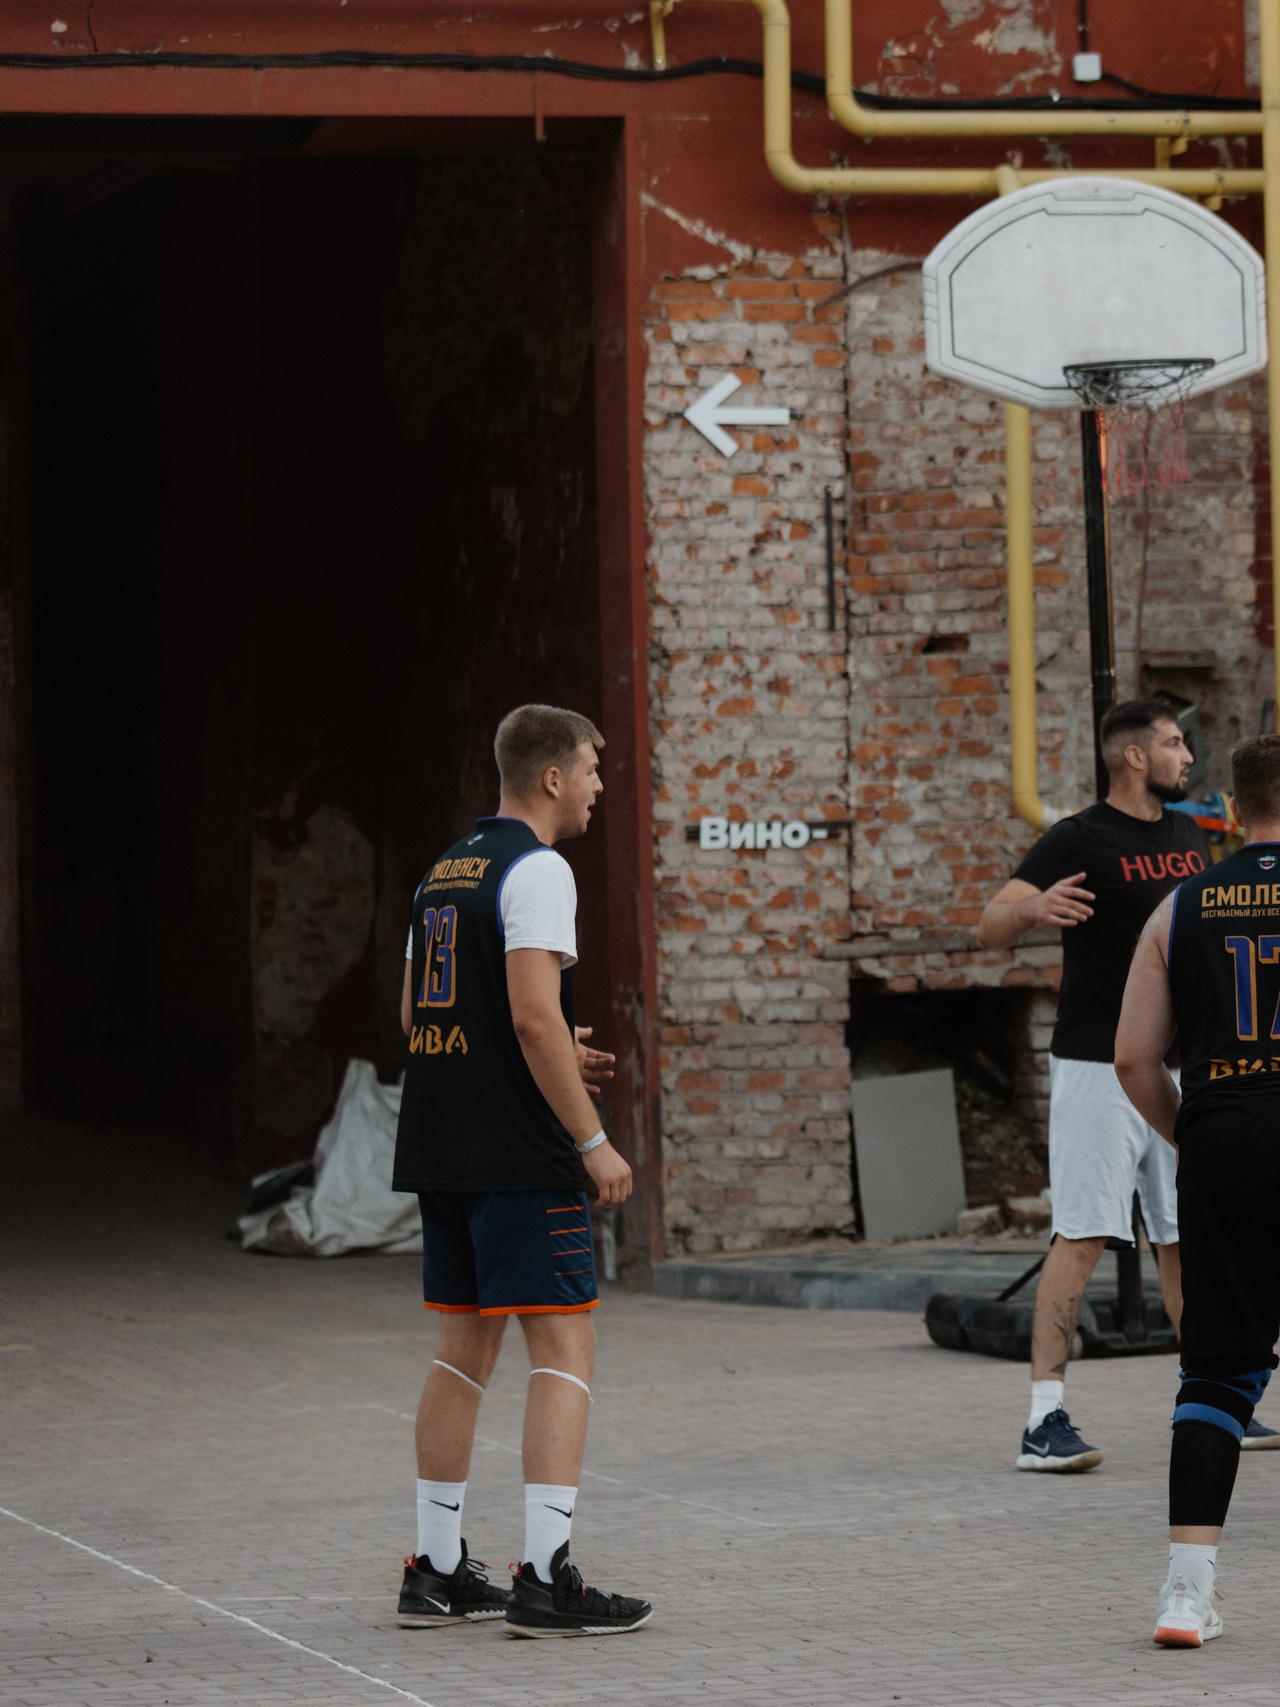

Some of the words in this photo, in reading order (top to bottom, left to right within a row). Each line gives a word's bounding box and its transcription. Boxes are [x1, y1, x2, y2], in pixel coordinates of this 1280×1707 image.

[1120, 850, 1205, 882] HUGO
[1201, 908, 1251, 919] НЕСГИБАЕМЫЙ
[1252, 908, 1267, 918] ДУХ
[1267, 907, 1280, 916] ВСЕ
[417, 905, 458, 1008] 13
